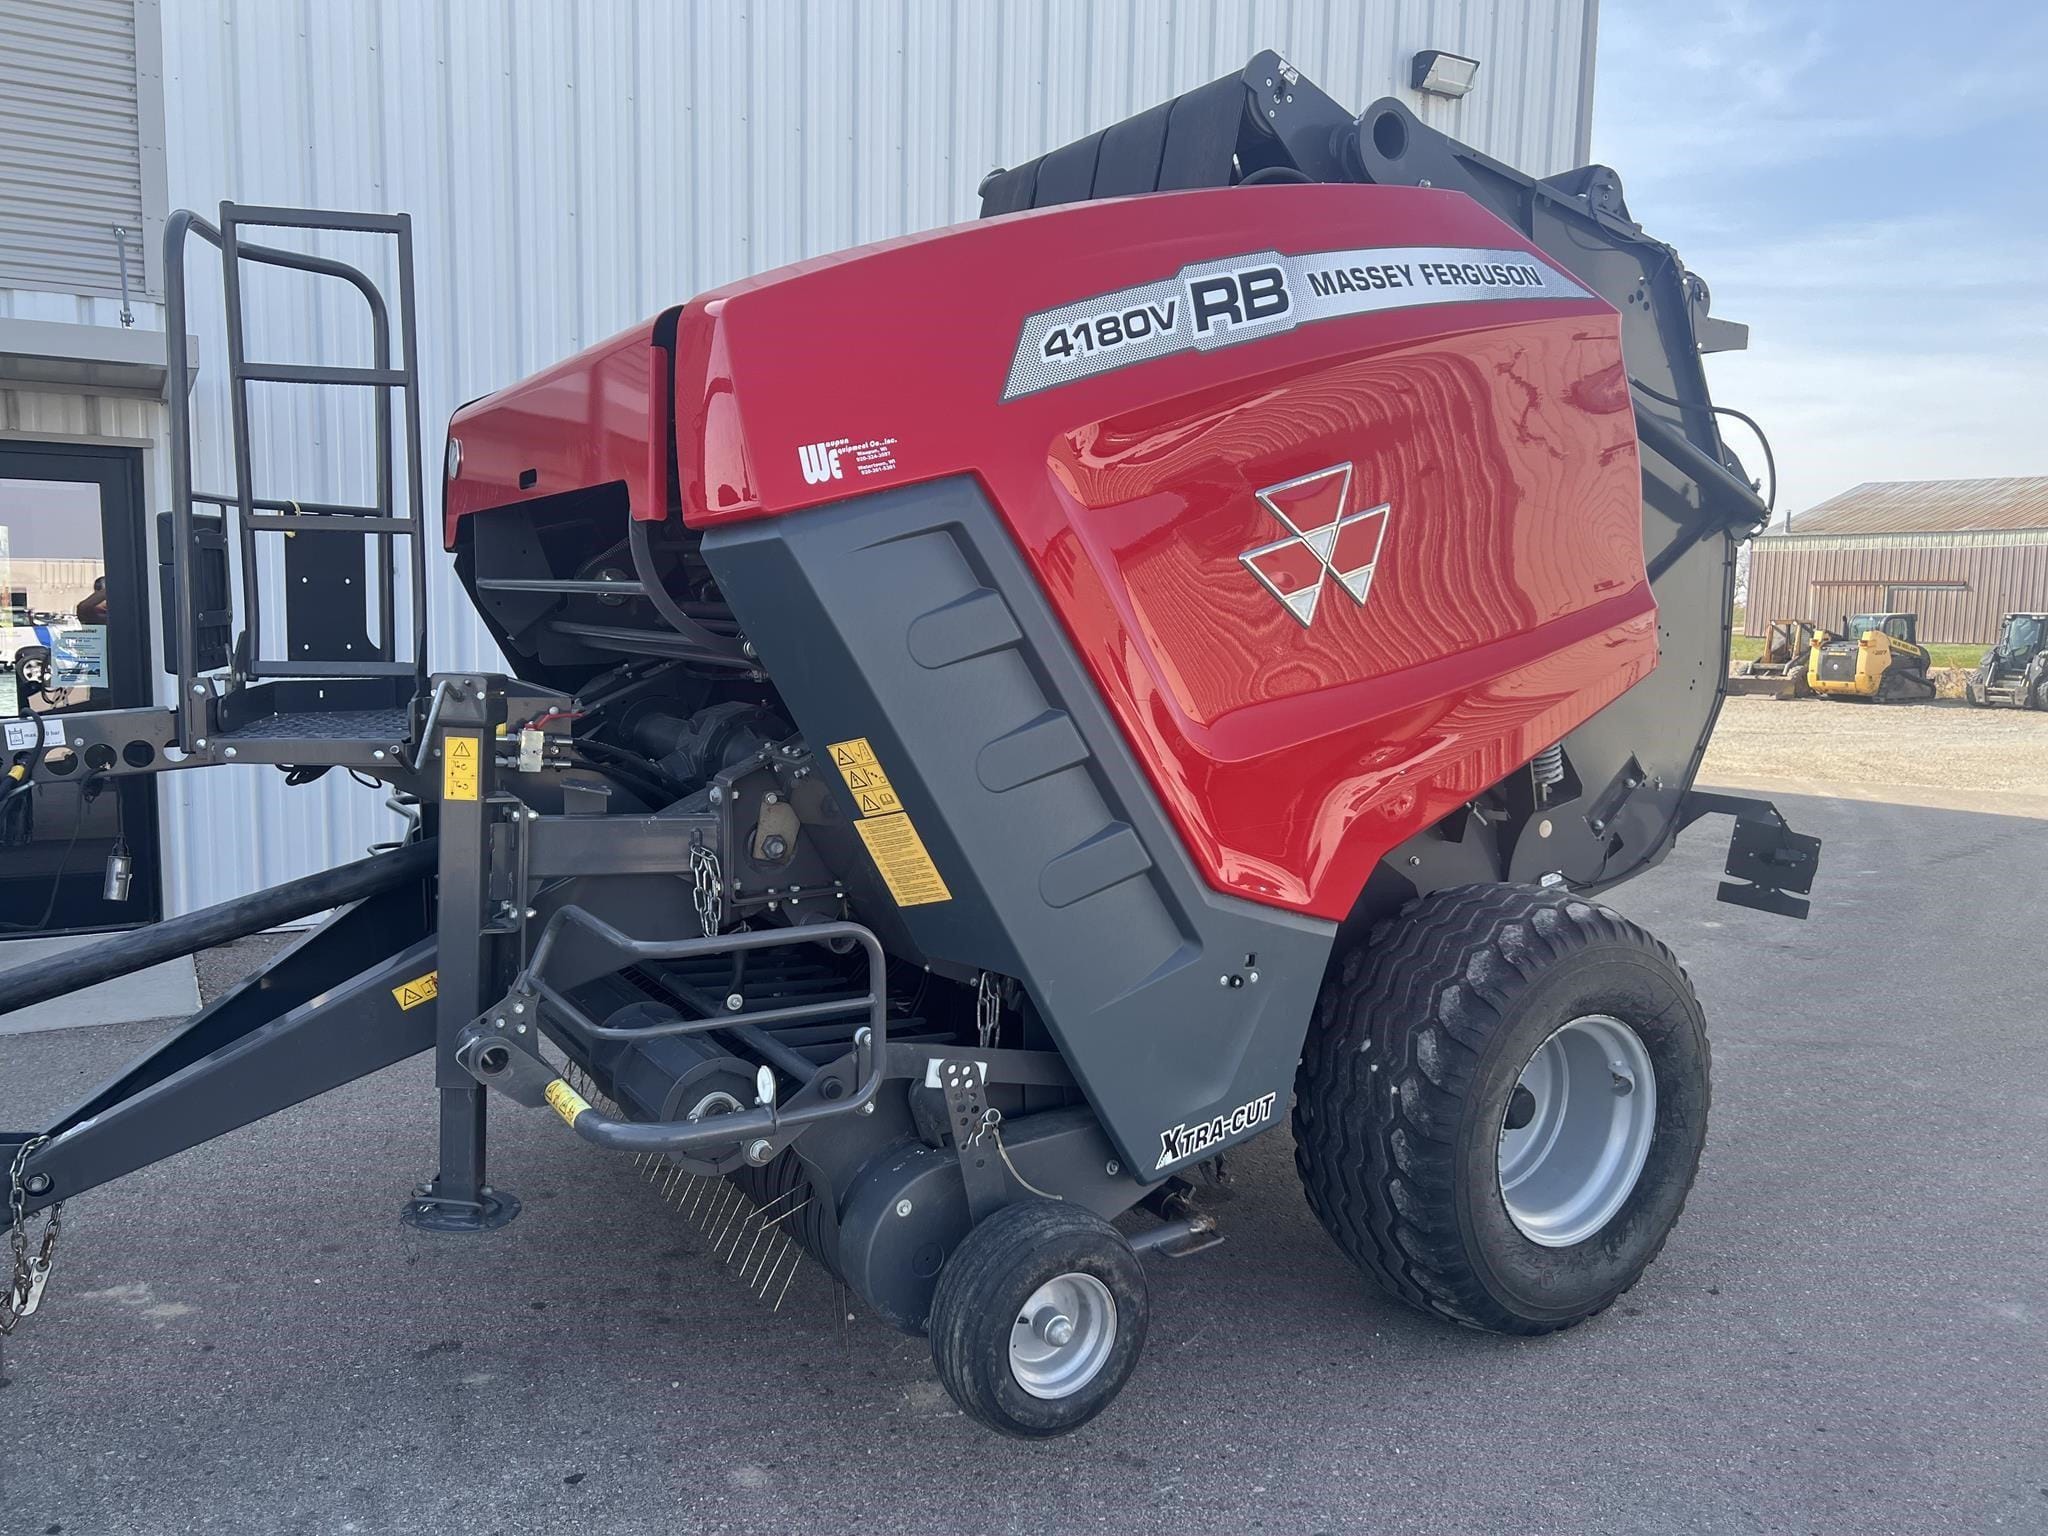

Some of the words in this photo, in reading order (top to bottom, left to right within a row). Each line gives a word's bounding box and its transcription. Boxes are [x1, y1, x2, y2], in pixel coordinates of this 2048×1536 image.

[1044, 301, 1175, 357] 4180V
[1190, 267, 1290, 332] RB
[1307, 264, 1414, 297] MASSEY
[1418, 263, 1543, 286] FERGUSON
